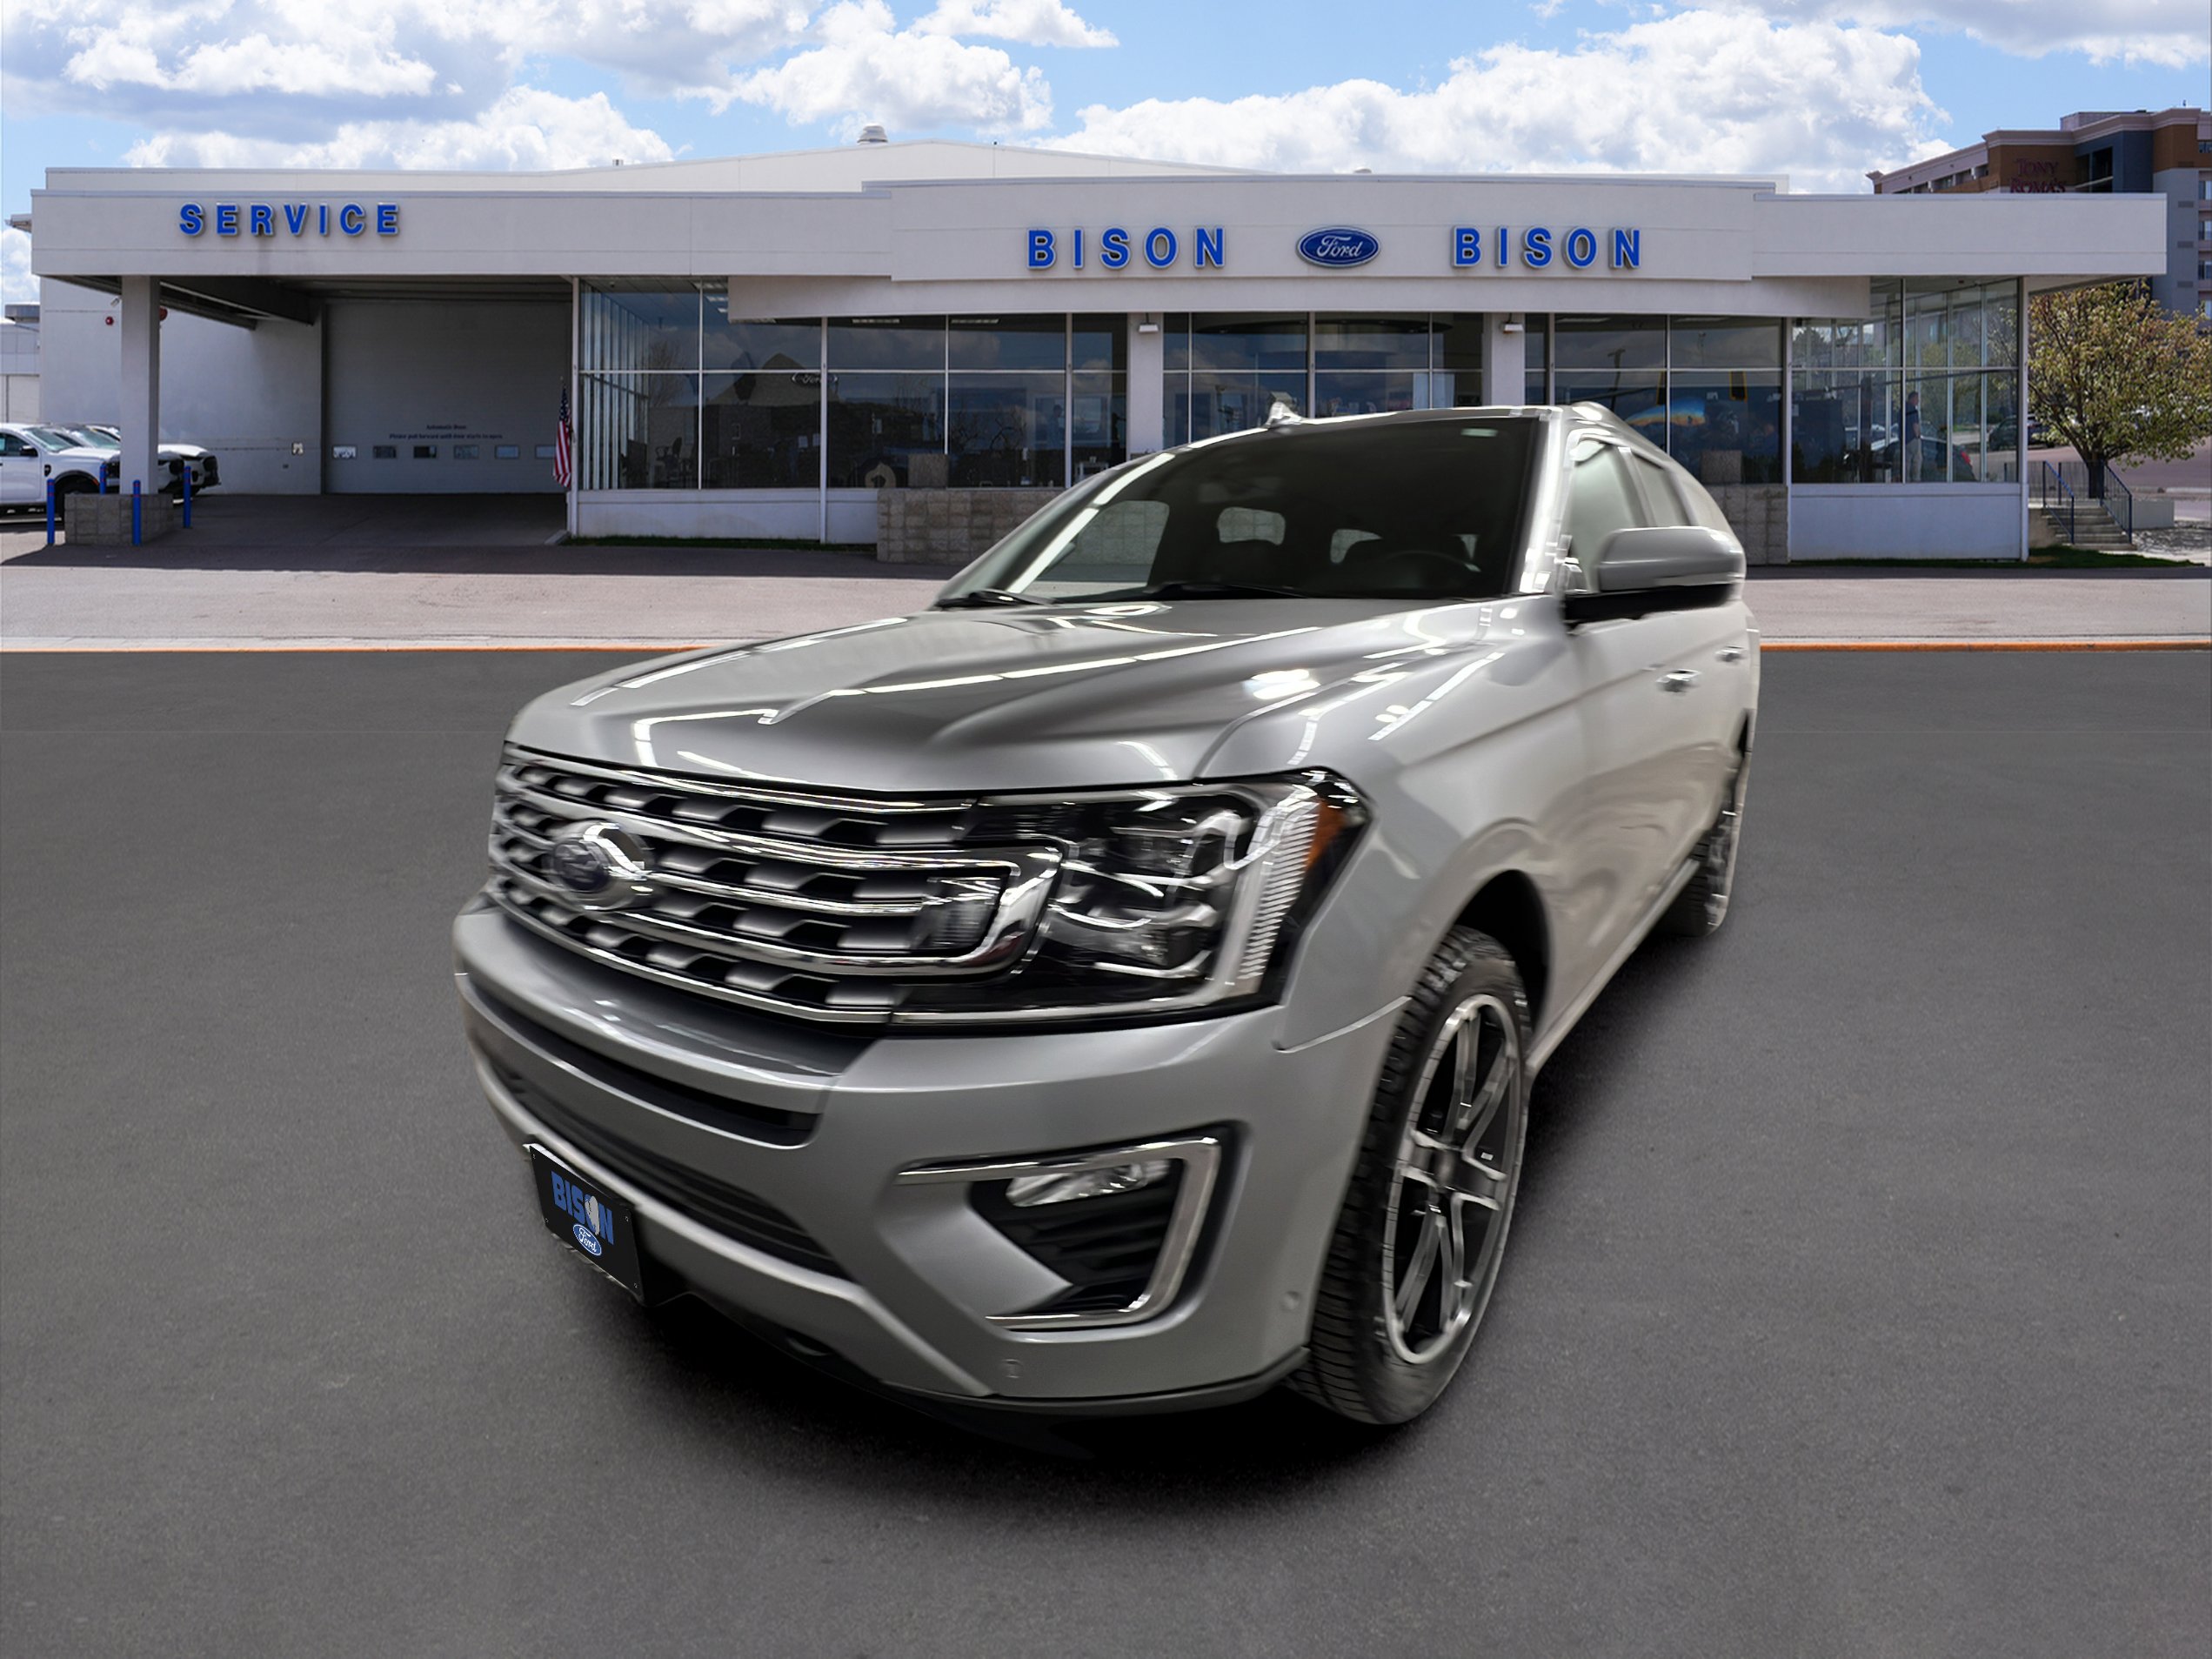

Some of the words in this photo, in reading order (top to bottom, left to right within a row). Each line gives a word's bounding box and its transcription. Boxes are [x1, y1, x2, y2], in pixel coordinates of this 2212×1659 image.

[2015, 157, 2059, 176] TONY
[179, 203, 401, 236] SERVICE
[1026, 227, 1226, 270] BISON
[1316, 235, 1363, 257] Ford
[1452, 226, 1643, 269] BISON
